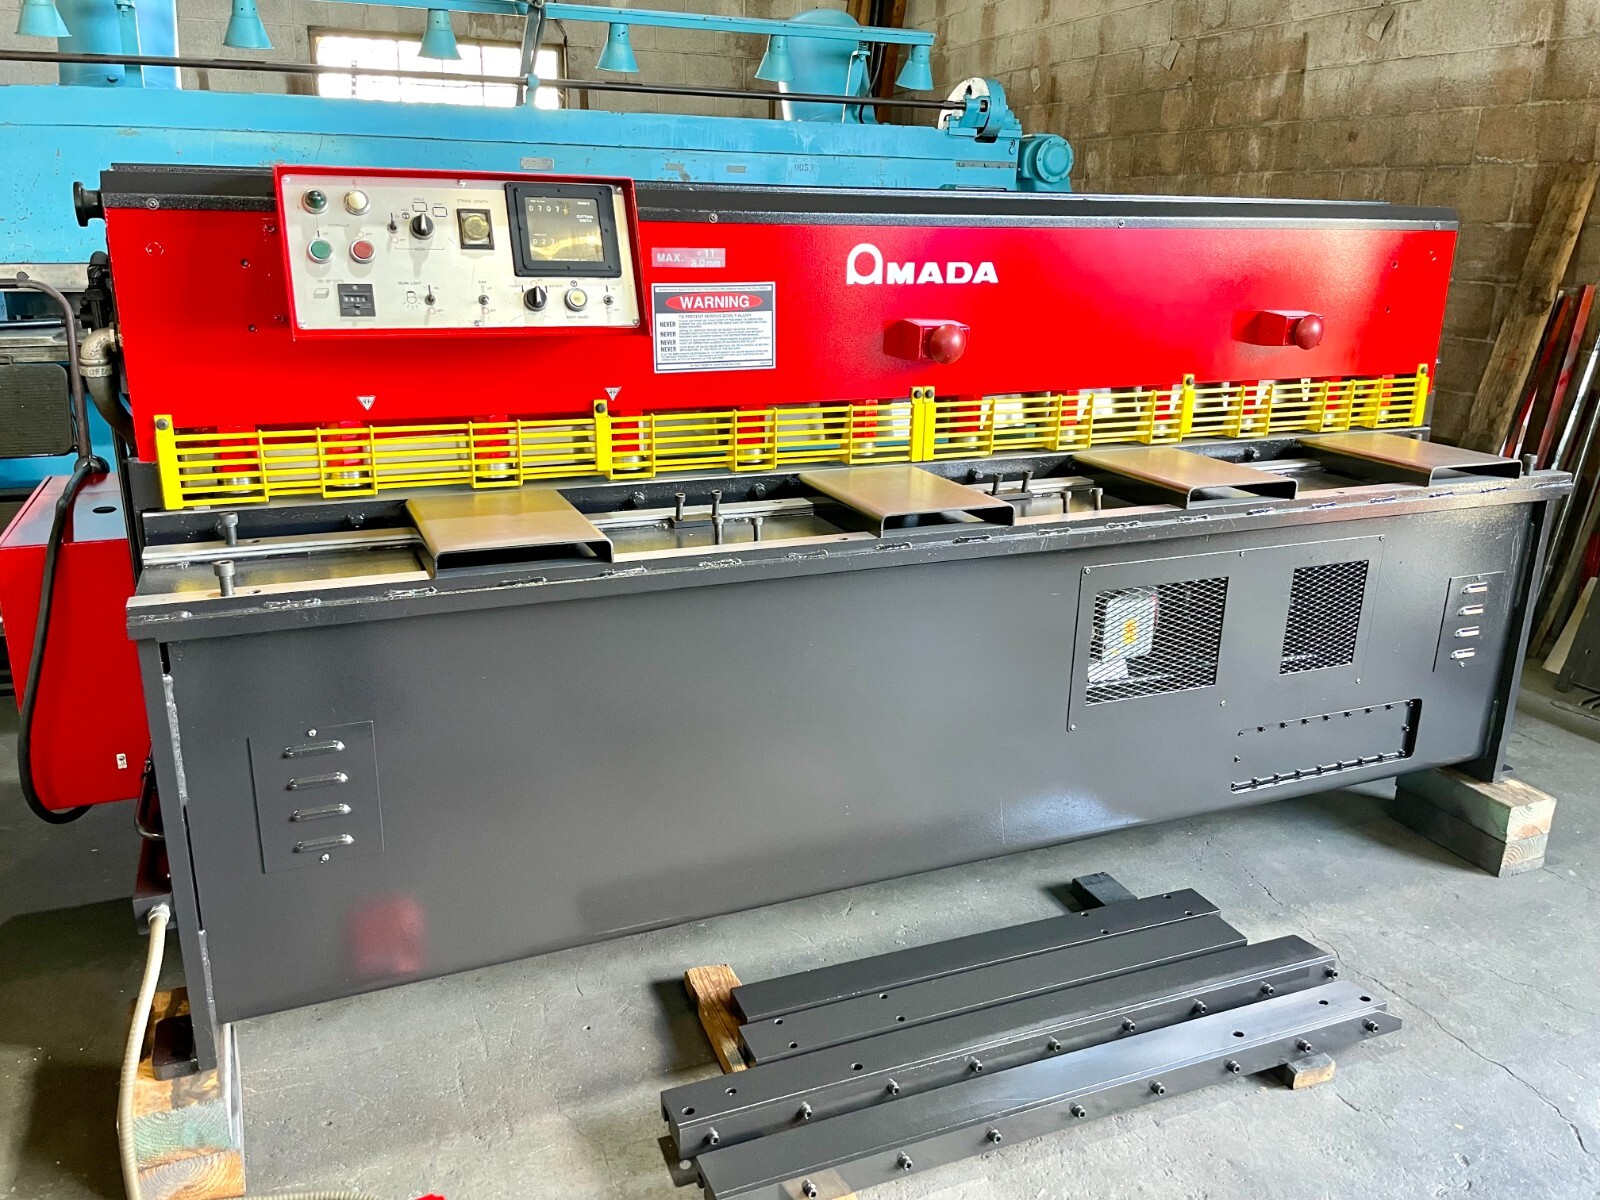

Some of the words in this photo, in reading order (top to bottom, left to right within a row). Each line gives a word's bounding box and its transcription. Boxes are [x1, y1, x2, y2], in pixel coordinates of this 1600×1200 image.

[656, 252, 685, 263] MAX.
[846, 242, 999, 285] AMADA
[679, 295, 750, 309] WARNING
